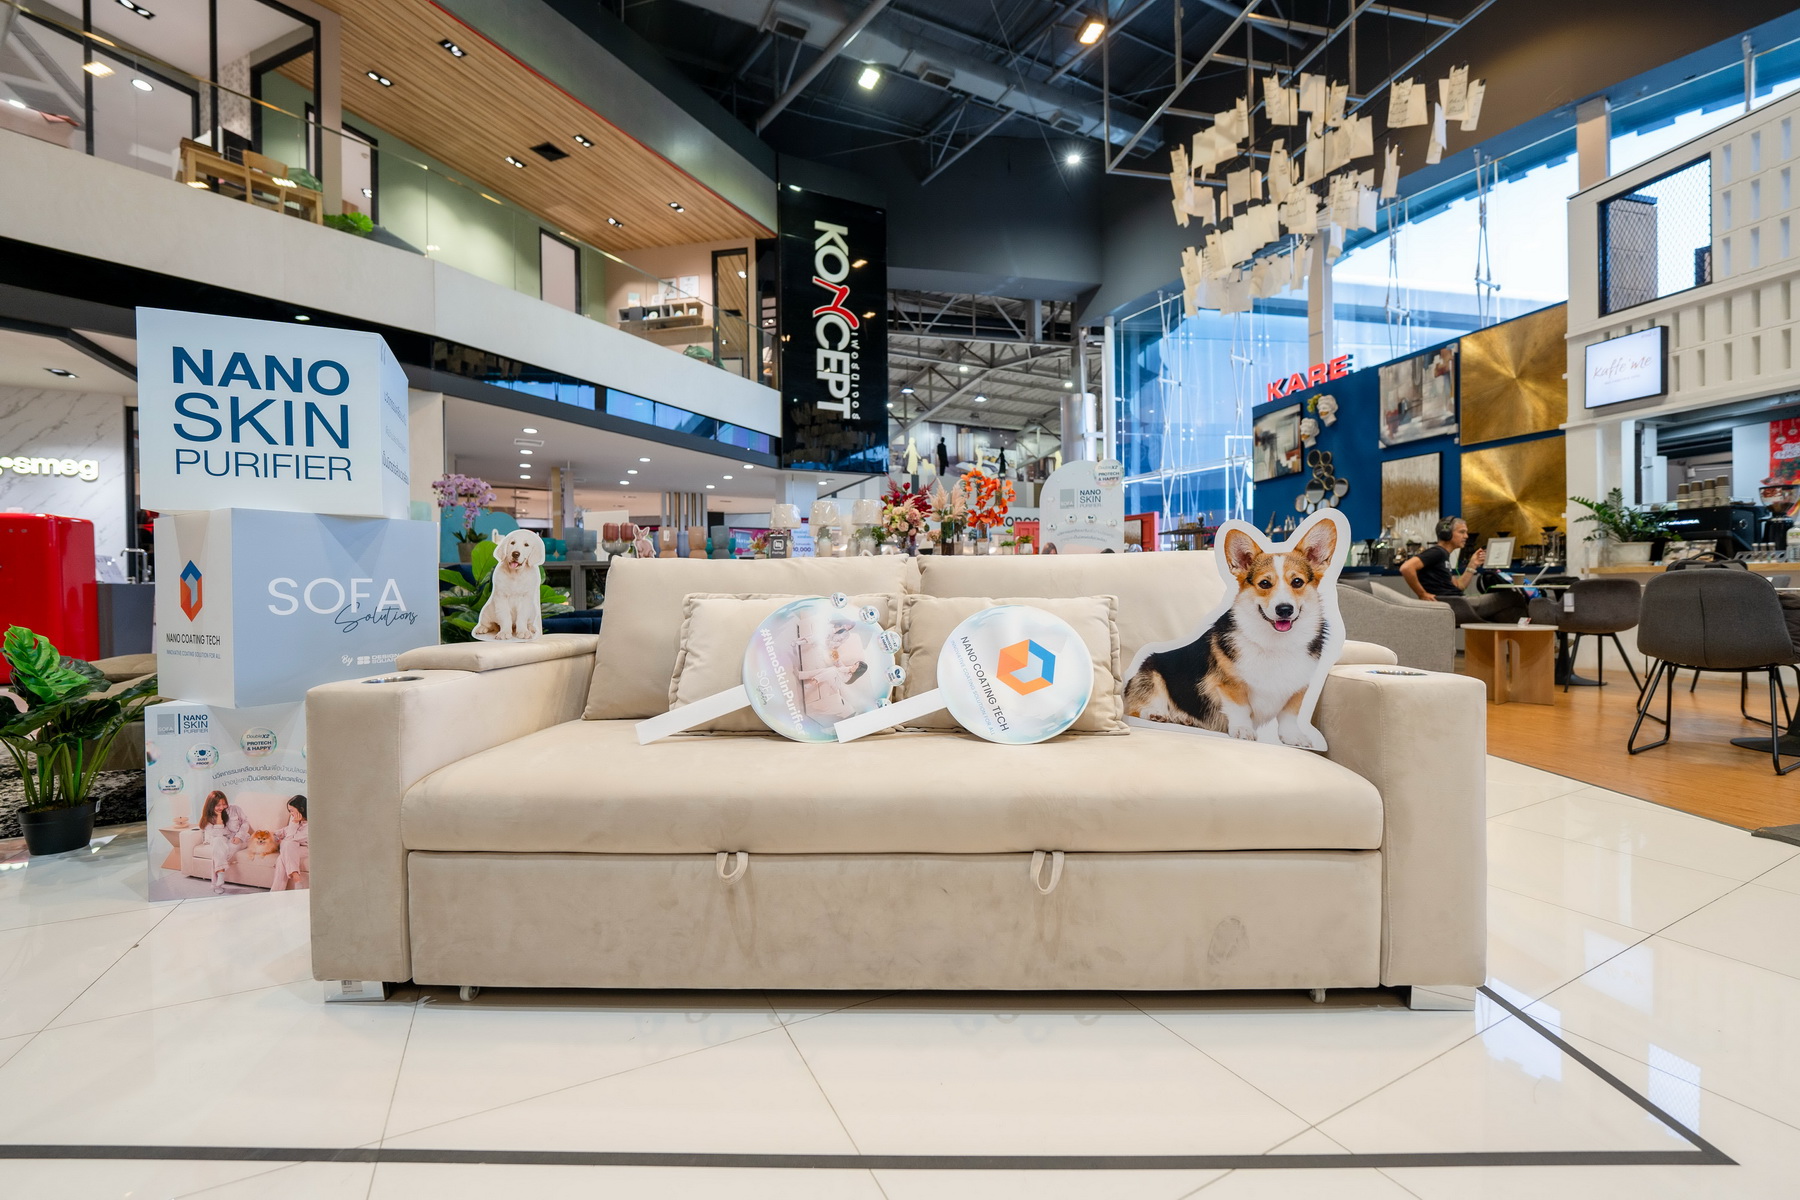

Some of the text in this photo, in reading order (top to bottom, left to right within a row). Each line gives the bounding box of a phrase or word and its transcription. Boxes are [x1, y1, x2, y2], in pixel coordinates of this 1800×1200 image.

[812, 220, 859, 419] KONCEPT
[172, 346, 350, 396] NANO
[1267, 354, 1351, 402] KARE
[173, 392, 350, 449] SKIN
[12, 456, 99, 482] smeg
[175, 448, 352, 481] PURIFIER
[1080, 495, 1101, 504] SKIN
[268, 577, 407, 615] SOFA
[334, 602, 418, 633] Solutions
[166, 633, 220, 645] NANO COATING TECH
[341, 655, 353, 666] By
[757, 670, 775, 703] SOFA
[760, 628, 806, 735] #NanoSkinPurifier
[960, 636, 1010, 732] NANO COATING TECH
[183, 720, 208, 729] SKIN
